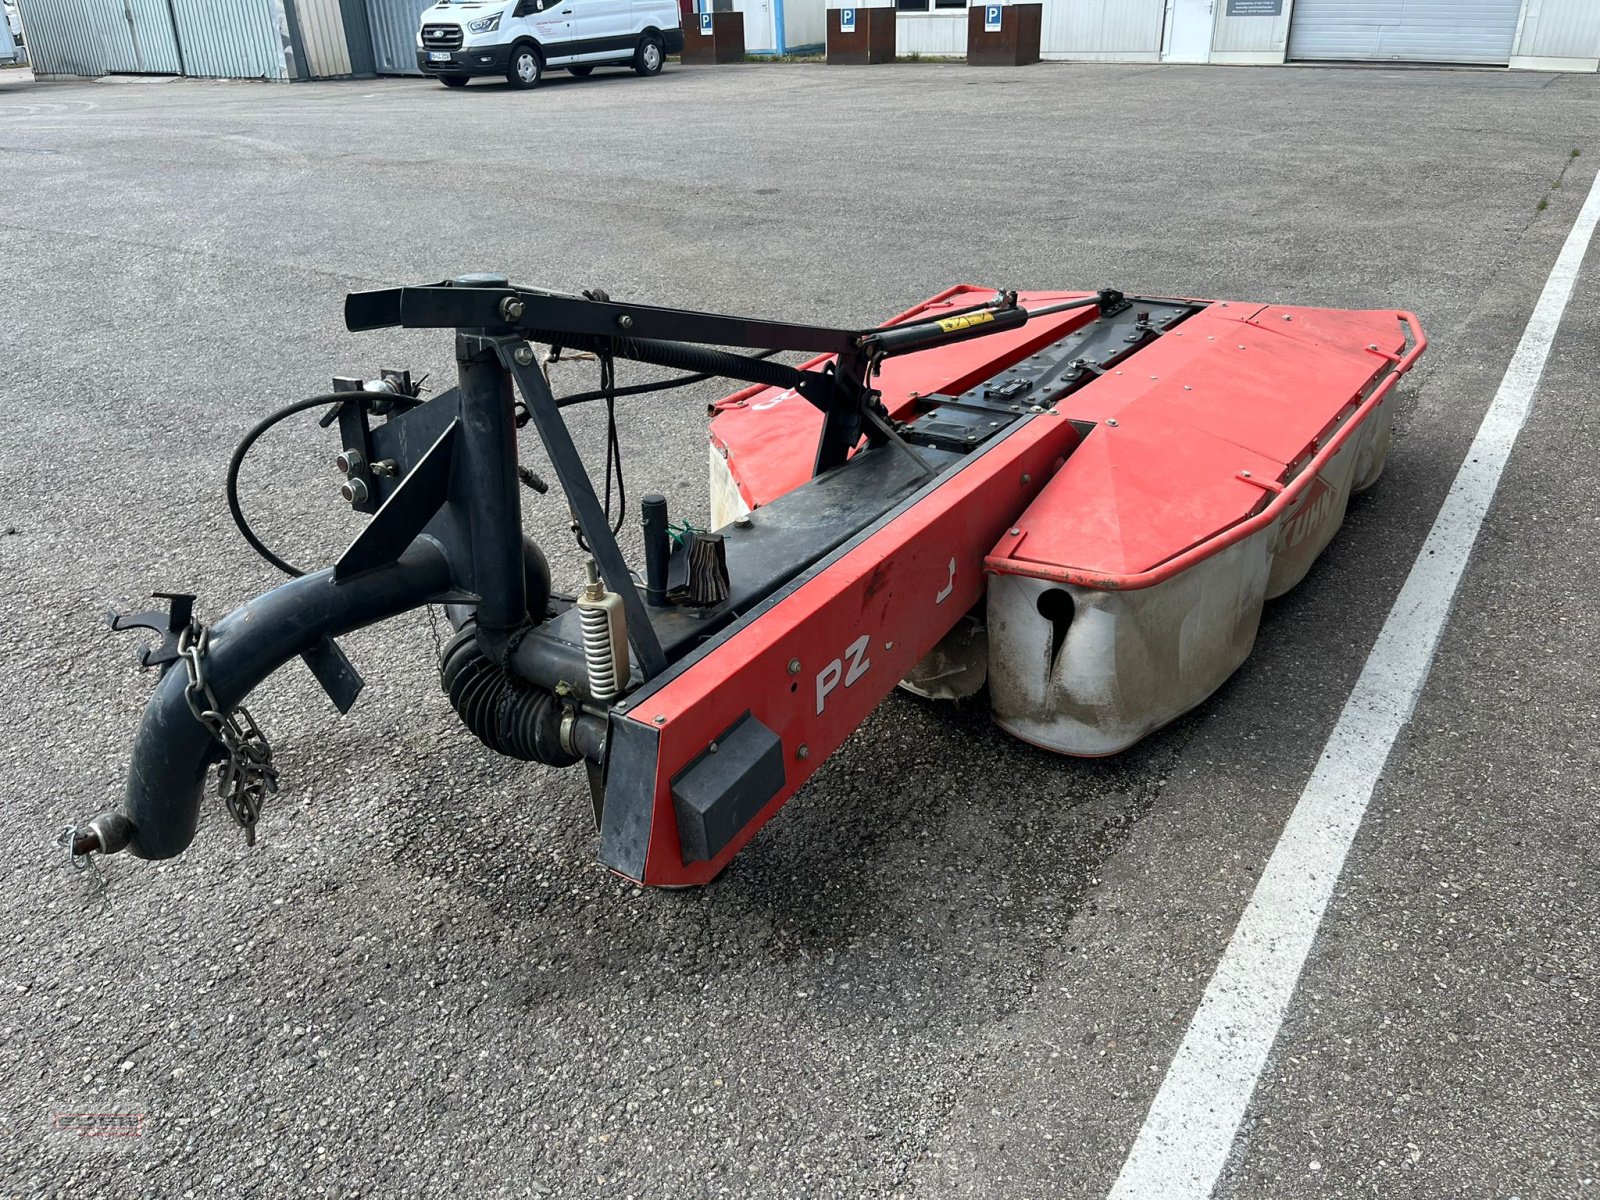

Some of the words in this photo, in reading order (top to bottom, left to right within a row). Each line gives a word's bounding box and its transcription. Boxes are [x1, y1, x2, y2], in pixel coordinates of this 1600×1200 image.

[702, 14, 710, 28] P
[844, 10, 852, 24] P
[988, 7, 998, 23] P
[815, 634, 871, 716] PZ
